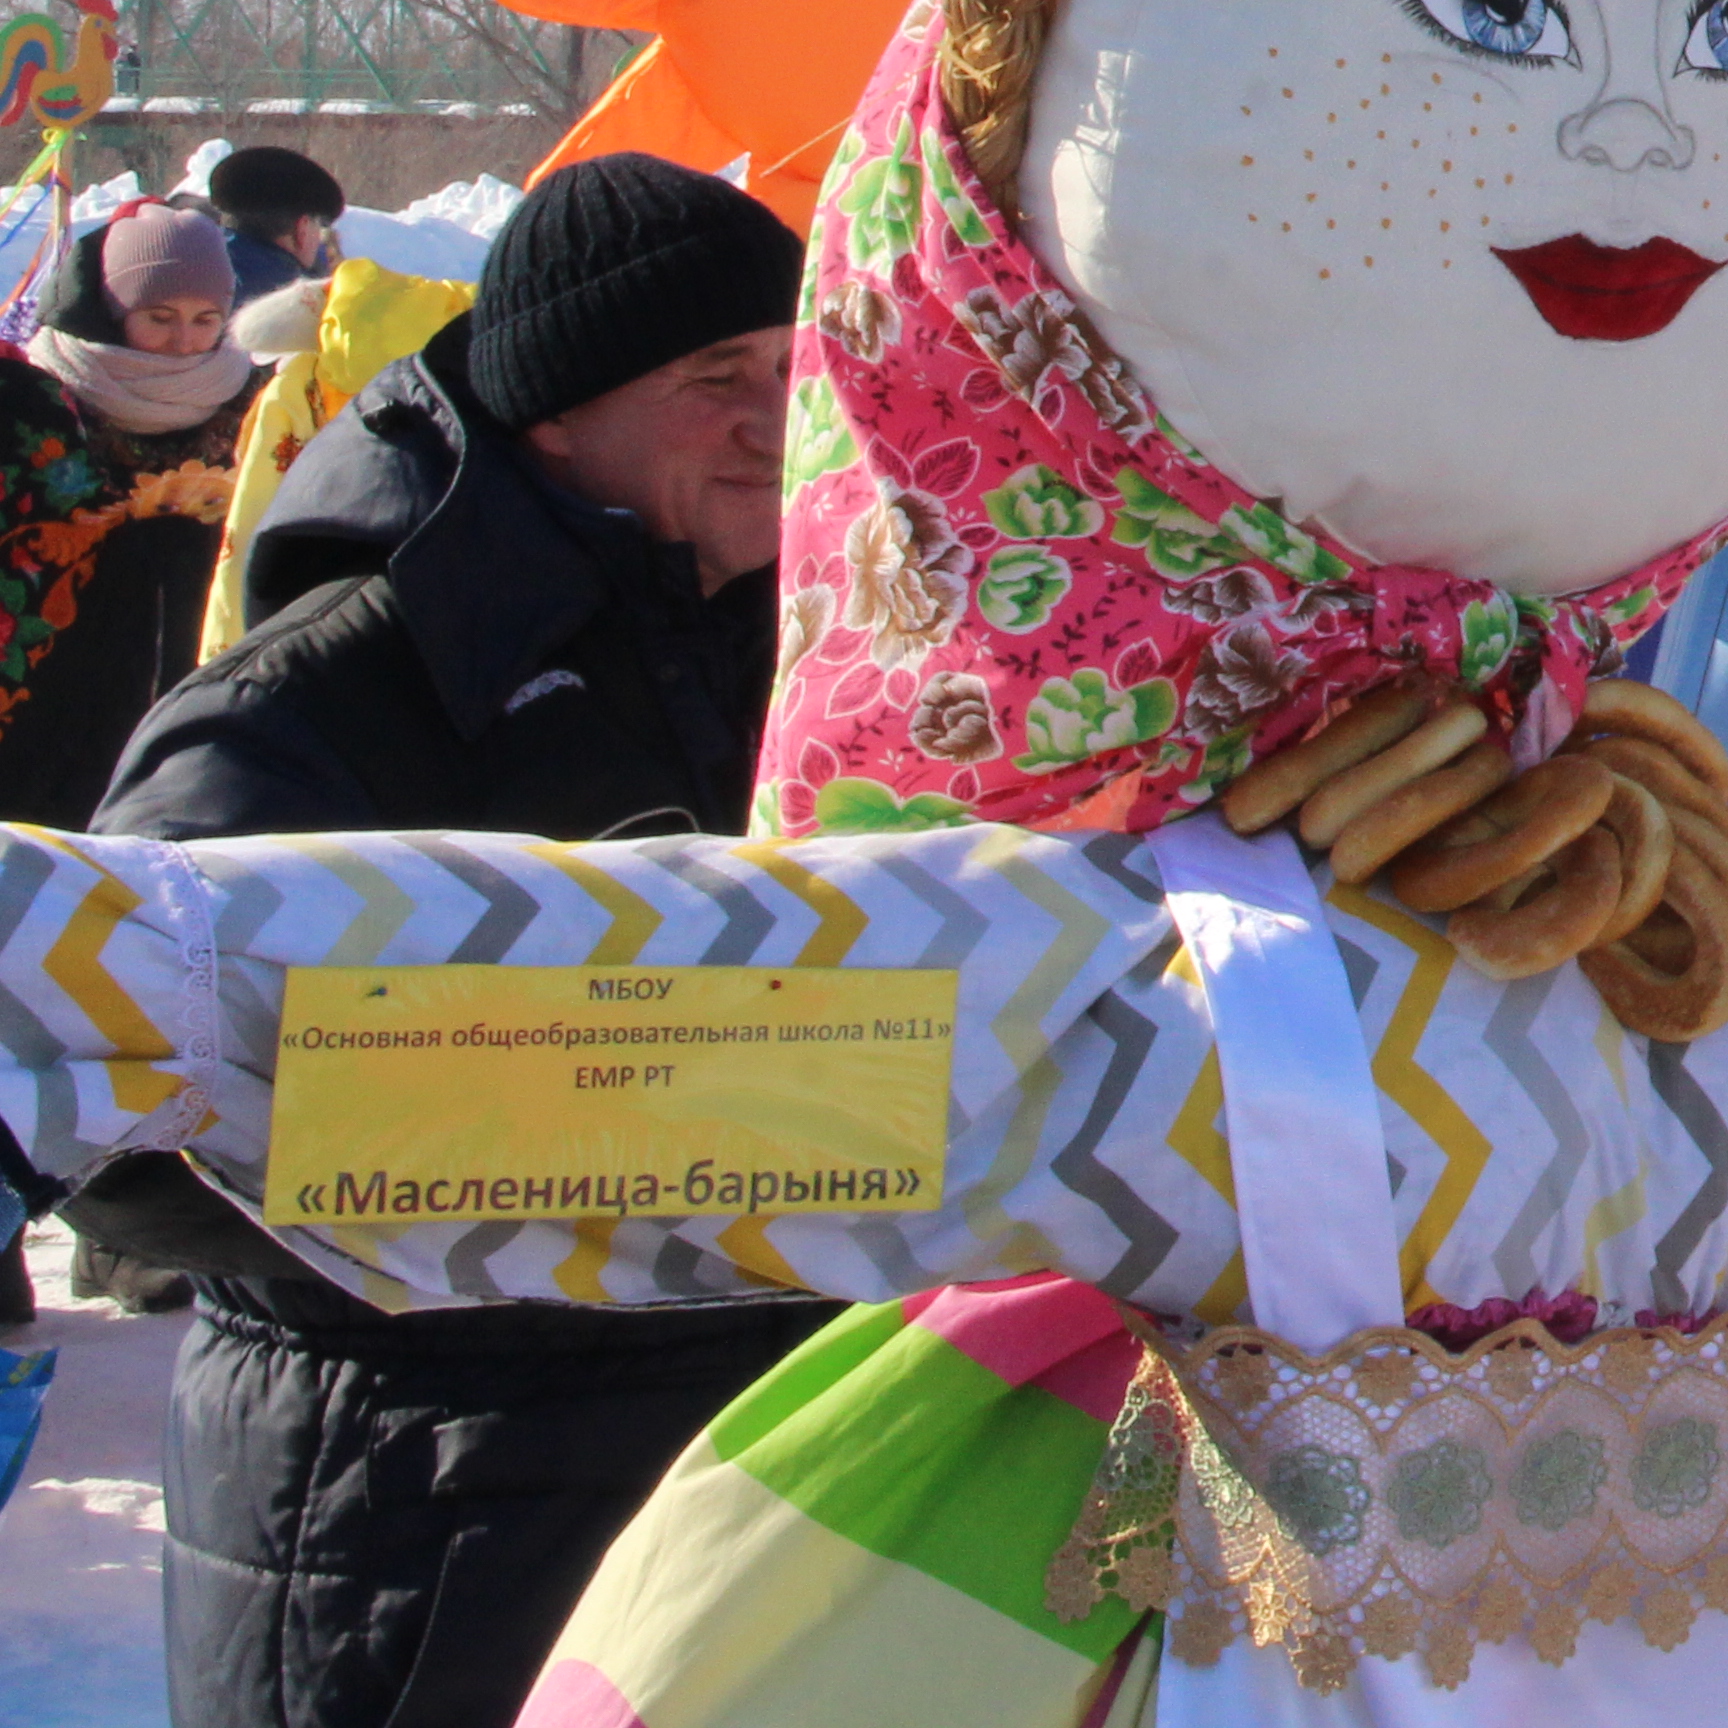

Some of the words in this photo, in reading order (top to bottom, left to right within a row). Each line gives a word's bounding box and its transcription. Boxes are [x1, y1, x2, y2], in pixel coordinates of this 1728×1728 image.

[588, 978, 674, 1001] МБОУ
[282, 1026, 442, 1050] «Основная
[451, 1022, 769, 1051] общеобразовательная
[777, 1023, 864, 1043] школа
[873, 1018, 951, 1041] №11»
[574, 1066, 635, 1089] ЕМР
[644, 1065, 676, 1088] РТ
[295, 1158, 921, 1216] «Масленица-барыня»
